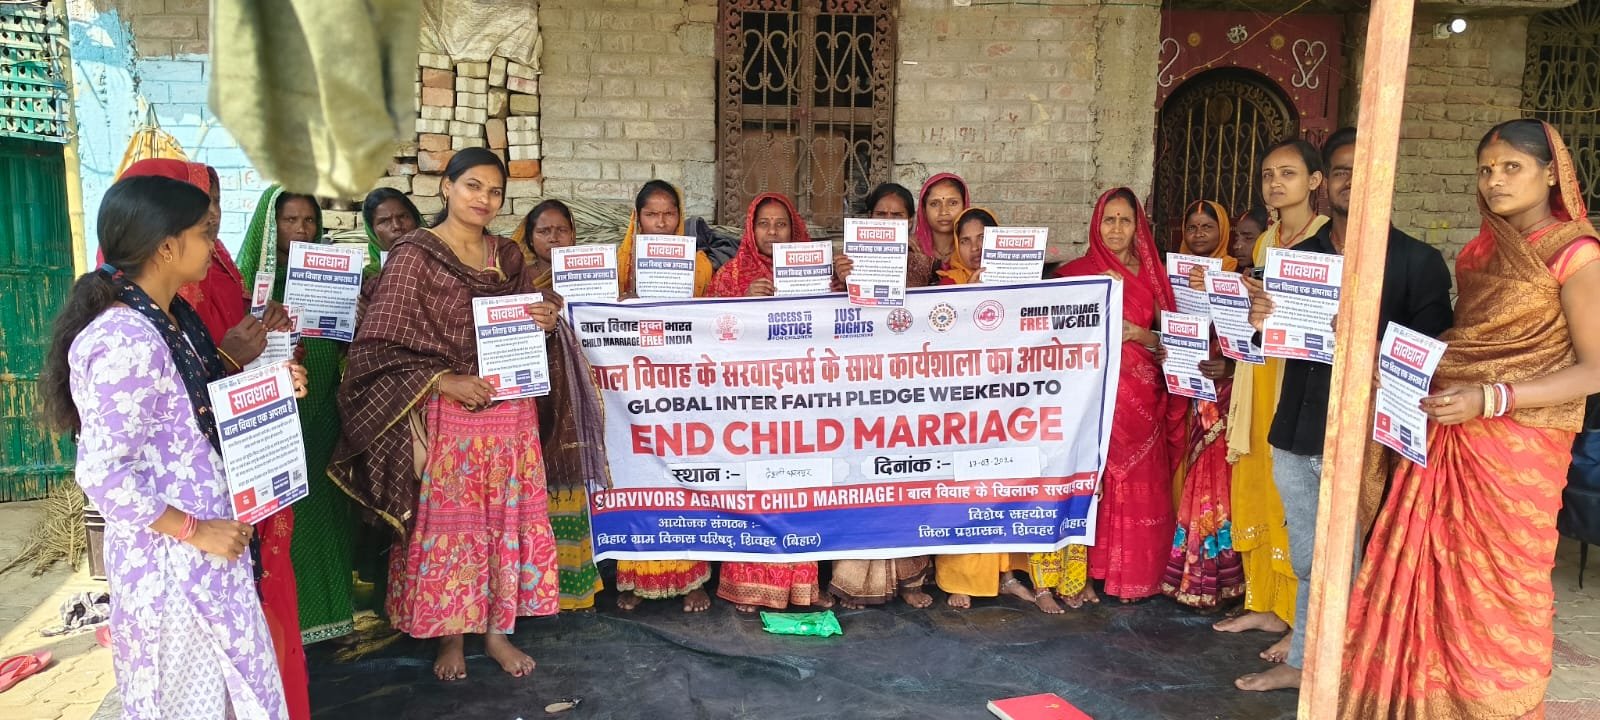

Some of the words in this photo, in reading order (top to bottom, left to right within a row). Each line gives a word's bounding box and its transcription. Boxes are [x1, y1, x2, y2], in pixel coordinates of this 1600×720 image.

[306, 254, 349, 269] सावधान!
[566, 255, 603, 267] सावधान!
[1283, 262, 1326, 280] सावधान!
[490, 305, 525, 320] सावधान
[835, 308, 861, 323] JUST
[1020, 305, 1049, 317] CHILD
[1051, 303, 1100, 316] MARRIAGE
[580, 321, 605, 333] बाल
[608, 318, 638, 333] विवाह
[641, 321, 662, 334] मुक्त
[665, 321, 692, 332] भारत
[834, 321, 873, 335] RIGHTS
[1019, 317, 1049, 332] FREE
[1052, 314, 1100, 330] WORLD
[768, 323, 812, 340] JUSTICE
[581, 338, 602, 348] CHILD
[603, 337, 640, 347] MARRIAGE
[641, 335, 664, 346] FREE
[665, 335, 693, 345] INDIA
[632, 355, 692, 390] विवाह
[697, 354, 717, 387] के
[721, 347, 816, 390] सरवाइवर्स
[819, 348, 841, 383] के
[844, 353, 884, 382] साथ
[888, 342, 982, 380] कार्यशाला
[986, 346, 1014, 374] का
[1016, 337, 1101, 373] आयोजन
[231, 382, 278, 410] सावधान!
[627, 398, 712, 415] GLOBAL
[716, 394, 777, 412] INTER
[781, 391, 841, 409] FAITH
[846, 387, 925, 406] PLEDGE
[929, 382, 1030, 402] WEEKEND
[1033, 379, 1062, 395] TO
[630, 422, 714, 457] END
[722, 418, 845, 456] CHILD
[853, 406, 1064, 450] MARRIAGE
[874, 455, 933, 475] दिनांक
[672, 467, 721, 484] स्थान
[595, 490, 685, 511] SURVIVORS
[691, 493, 756, 510] AGAINST
[761, 491, 808, 510] CHILD
[813, 486, 894, 507] MARRIAGE
[907, 487, 931, 500] बाल
[936, 484, 970, 499] विवाह
[976, 483, 986, 497] के
[993, 480, 1039, 498] खिलाफ
[968, 507, 1005, 520] विशेष
[1010, 507, 1057, 520] सहयोग
[658, 516, 707, 529] आयोजक
[710, 515, 748, 530] संगठन
[918, 525, 951, 538] जिला
[955, 525, 1007, 538] प्रशासन,
[1012, 523, 1055, 537] शिवहर
[597, 532, 627, 547] बिहार
[631, 534, 655, 545] ग्राम
[659, 532, 696, 545] विकास
[741, 533, 776, 546] शिवहर
[783, 532, 822, 549] (बिहार)
